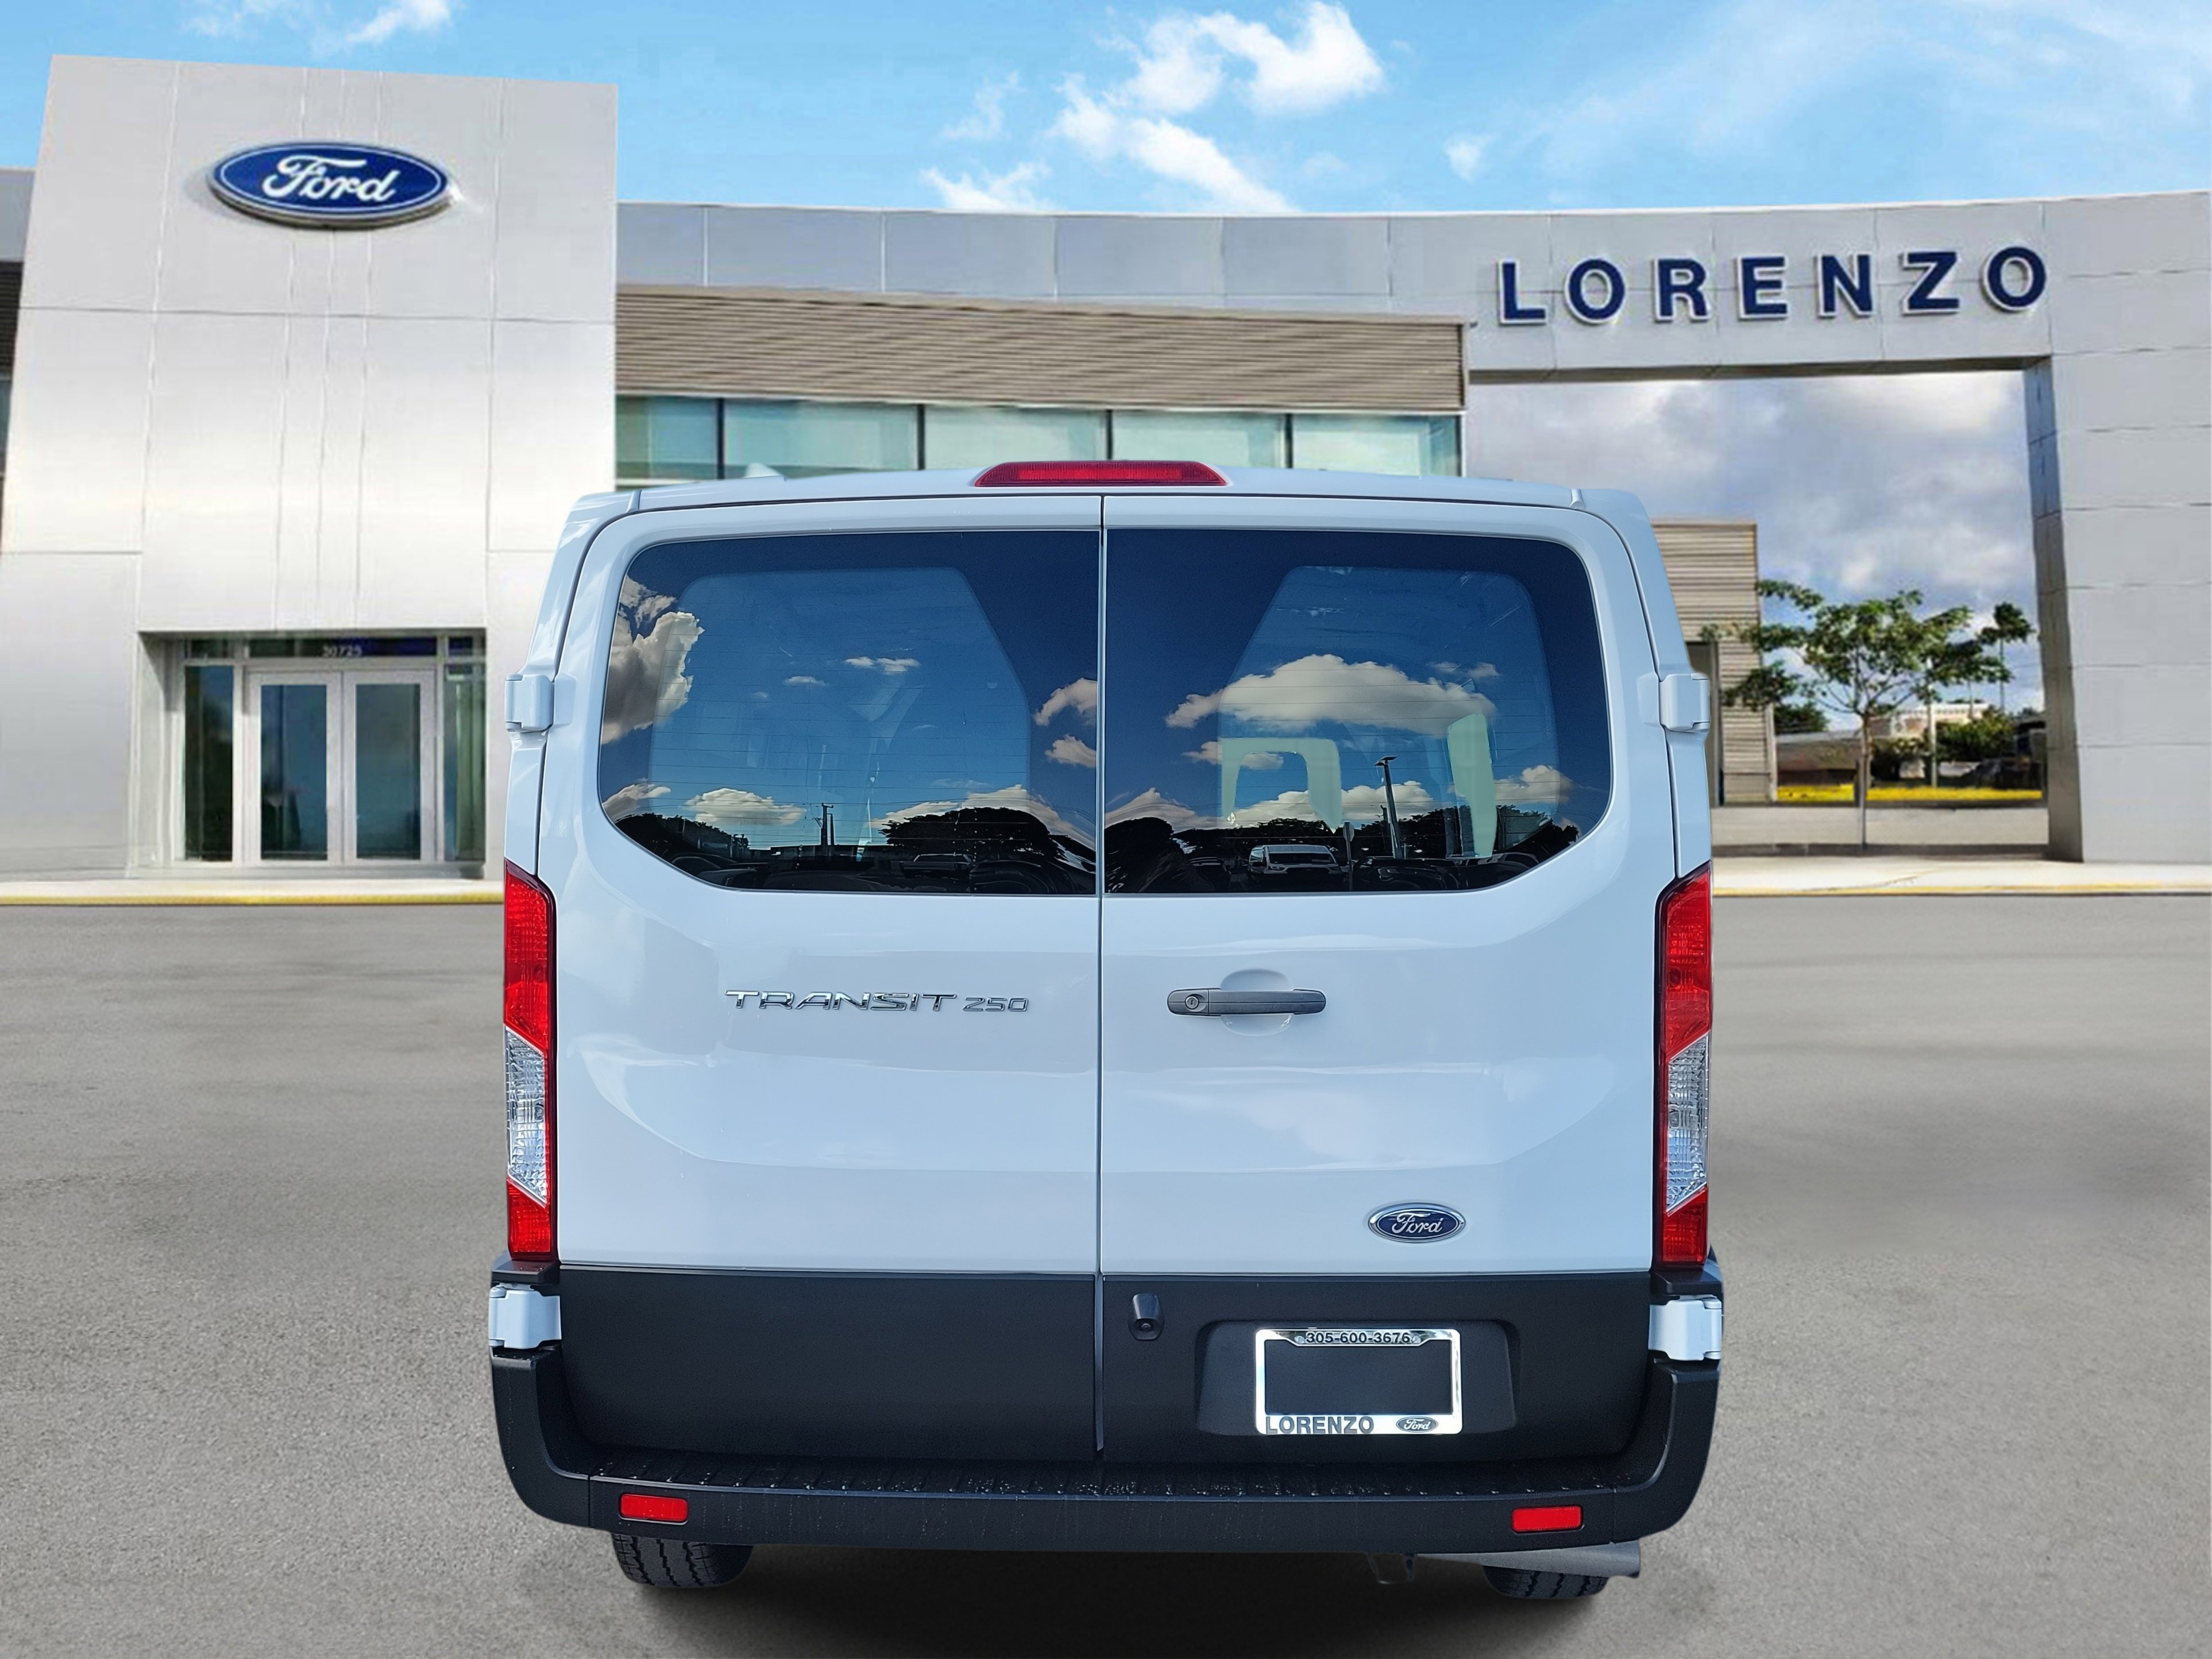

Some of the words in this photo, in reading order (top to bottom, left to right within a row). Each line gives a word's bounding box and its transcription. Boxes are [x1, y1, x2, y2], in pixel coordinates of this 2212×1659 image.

[262, 155, 400, 202] Ford
[1497, 246, 2047, 326] LORENZO
[725, 990, 957, 1012] TRANSIT
[962, 997, 1029, 1012] 250
[1391, 1212, 1444, 1233] Ford
[1304, 1332, 1411, 1344] 305-600-3676
[1265, 1416, 1375, 1434] LORENZO
[1403, 1418, 1432, 1430] Ford
